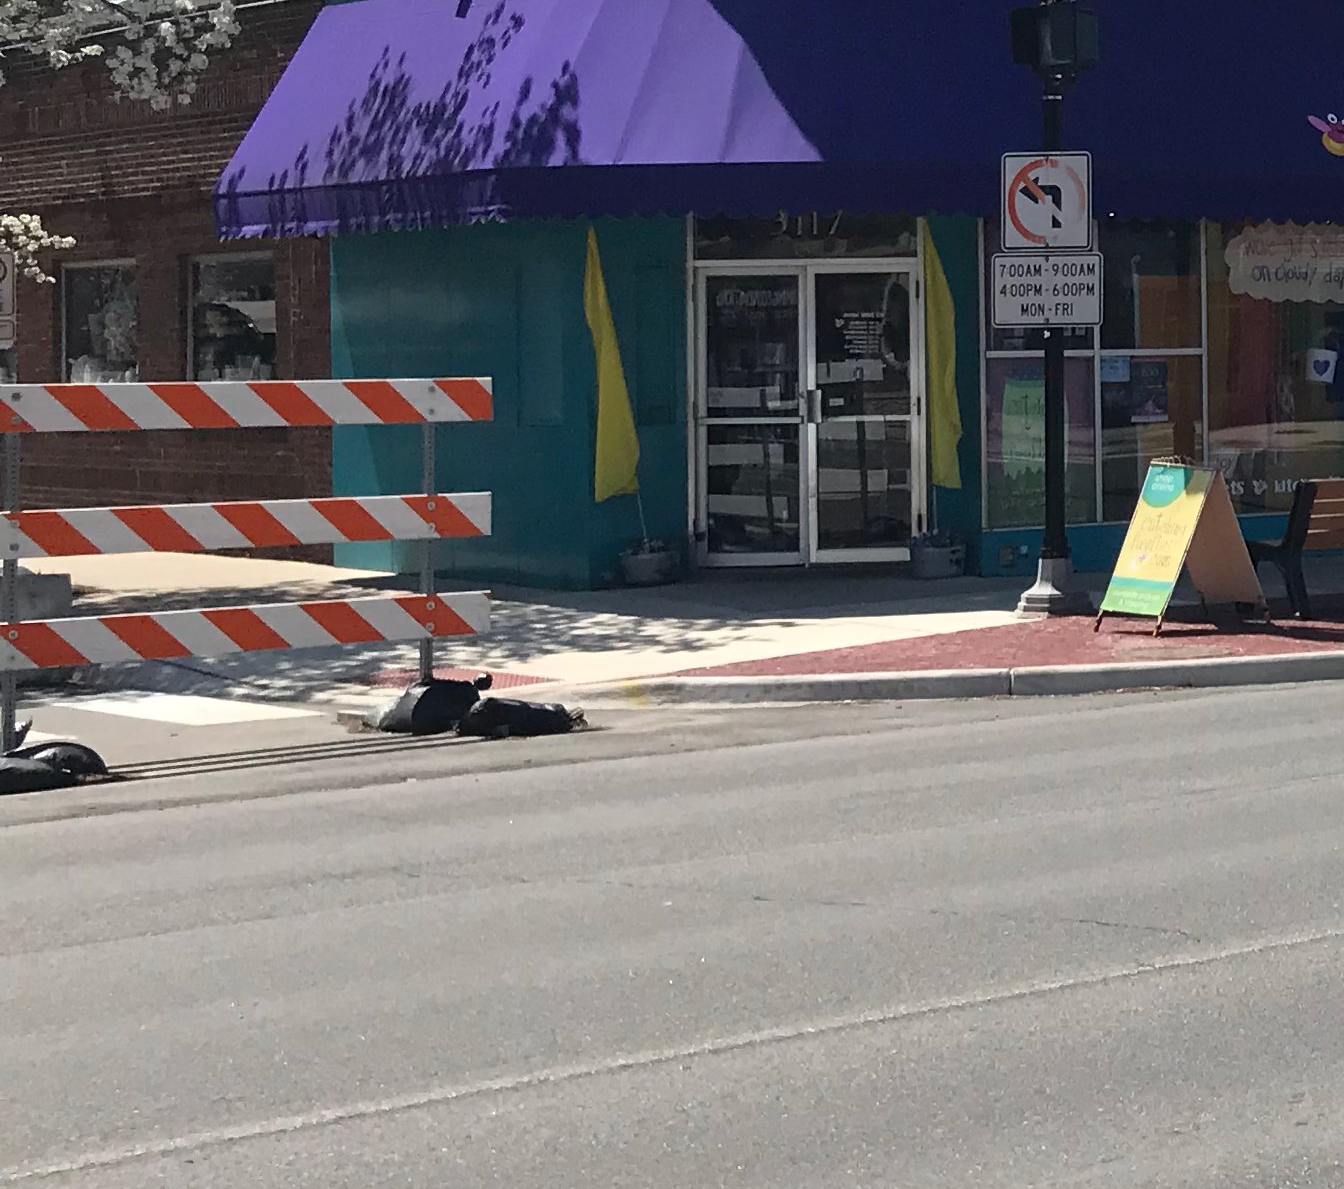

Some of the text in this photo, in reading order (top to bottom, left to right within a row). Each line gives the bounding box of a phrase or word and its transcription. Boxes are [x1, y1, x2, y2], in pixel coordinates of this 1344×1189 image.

[1000, 264, 1042, 277] 7:00AM
[1052, 263, 1095, 276] 9:00AM
[1000, 284, 1042, 297] 4:00PM
[1052, 283, 1095, 296] 6:00PM
[1021, 304, 1045, 316] MON
[1055, 303, 1073, 316] FRI
